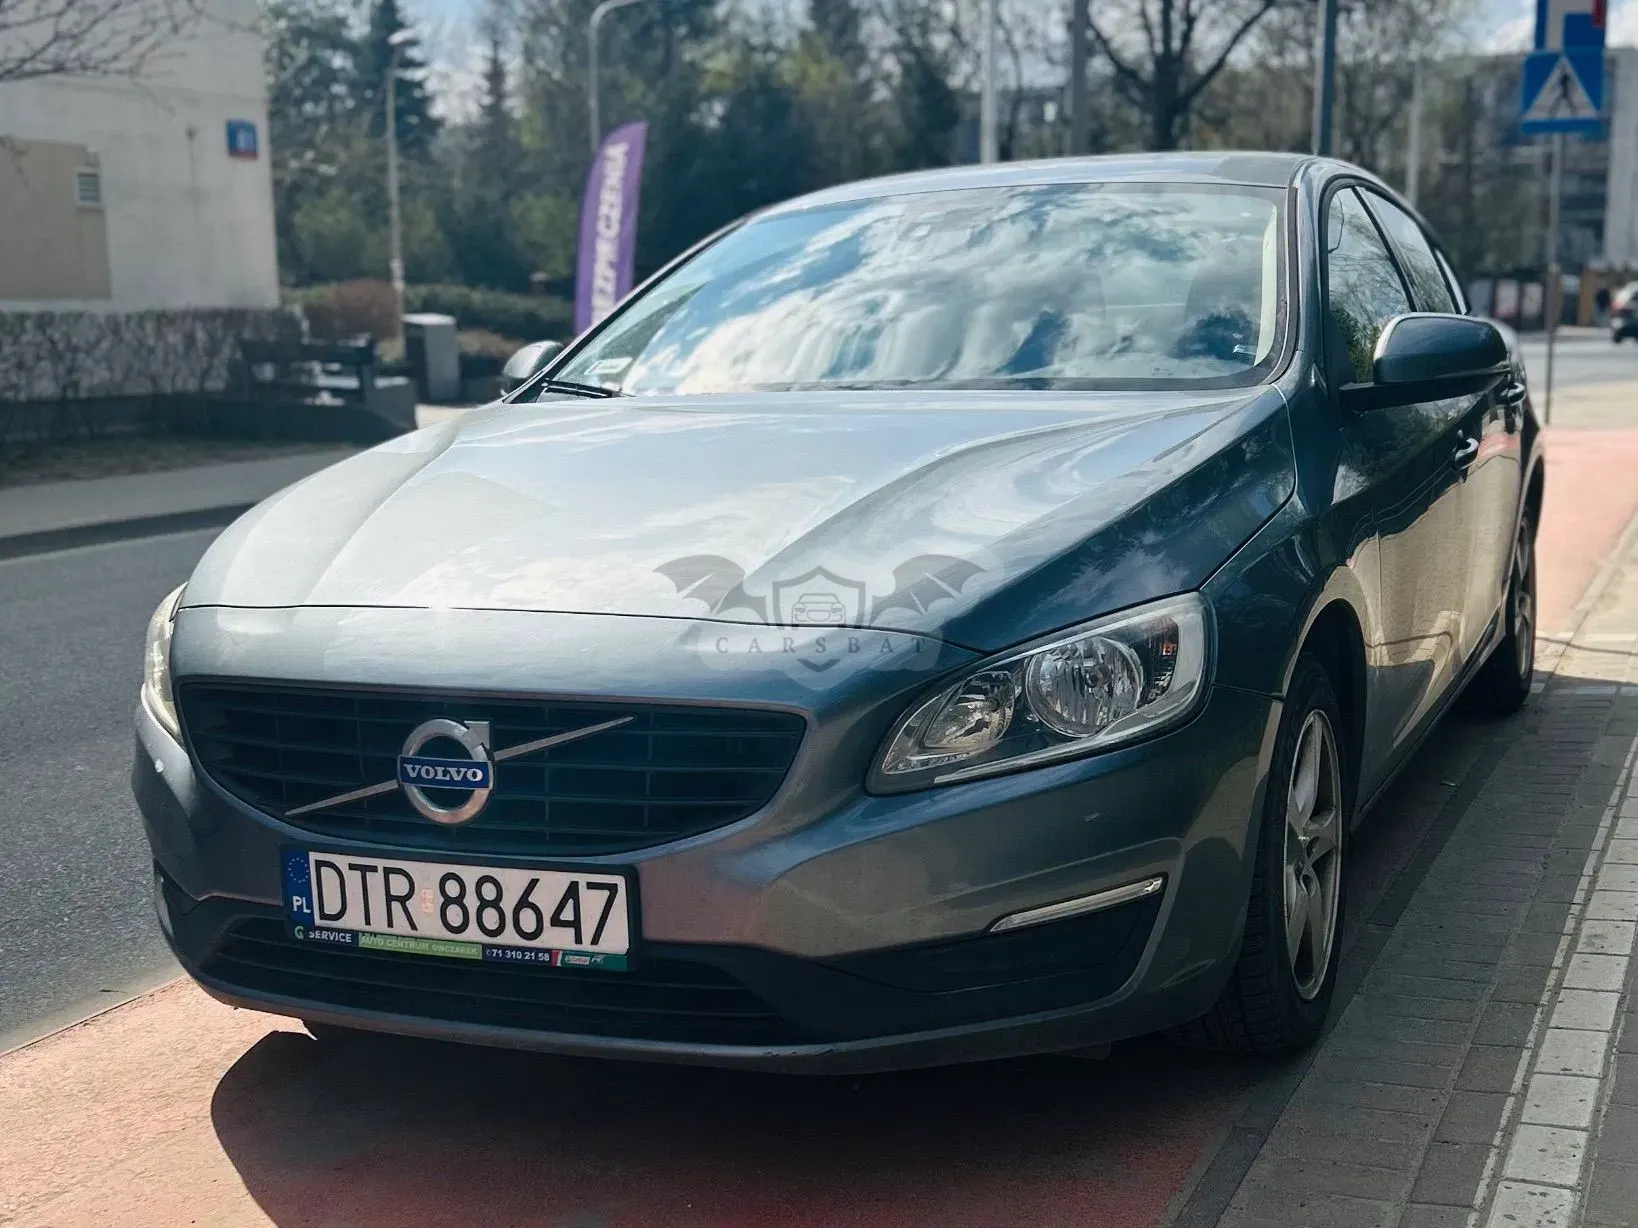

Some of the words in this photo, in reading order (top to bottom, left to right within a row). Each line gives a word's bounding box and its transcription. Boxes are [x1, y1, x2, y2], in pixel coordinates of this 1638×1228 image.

[404, 763, 484, 782] VOLVO
[292, 895, 311, 914] PL
[314, 859, 418, 931] DTR
[439, 872, 619, 946] 88647
[308, 930, 352, 943] SERVICE
[492, 949, 503, 958] 71
[505, 949, 522, 959] 310
[524, 950, 536, 960] 21
[538, 952, 550, 961] 58
